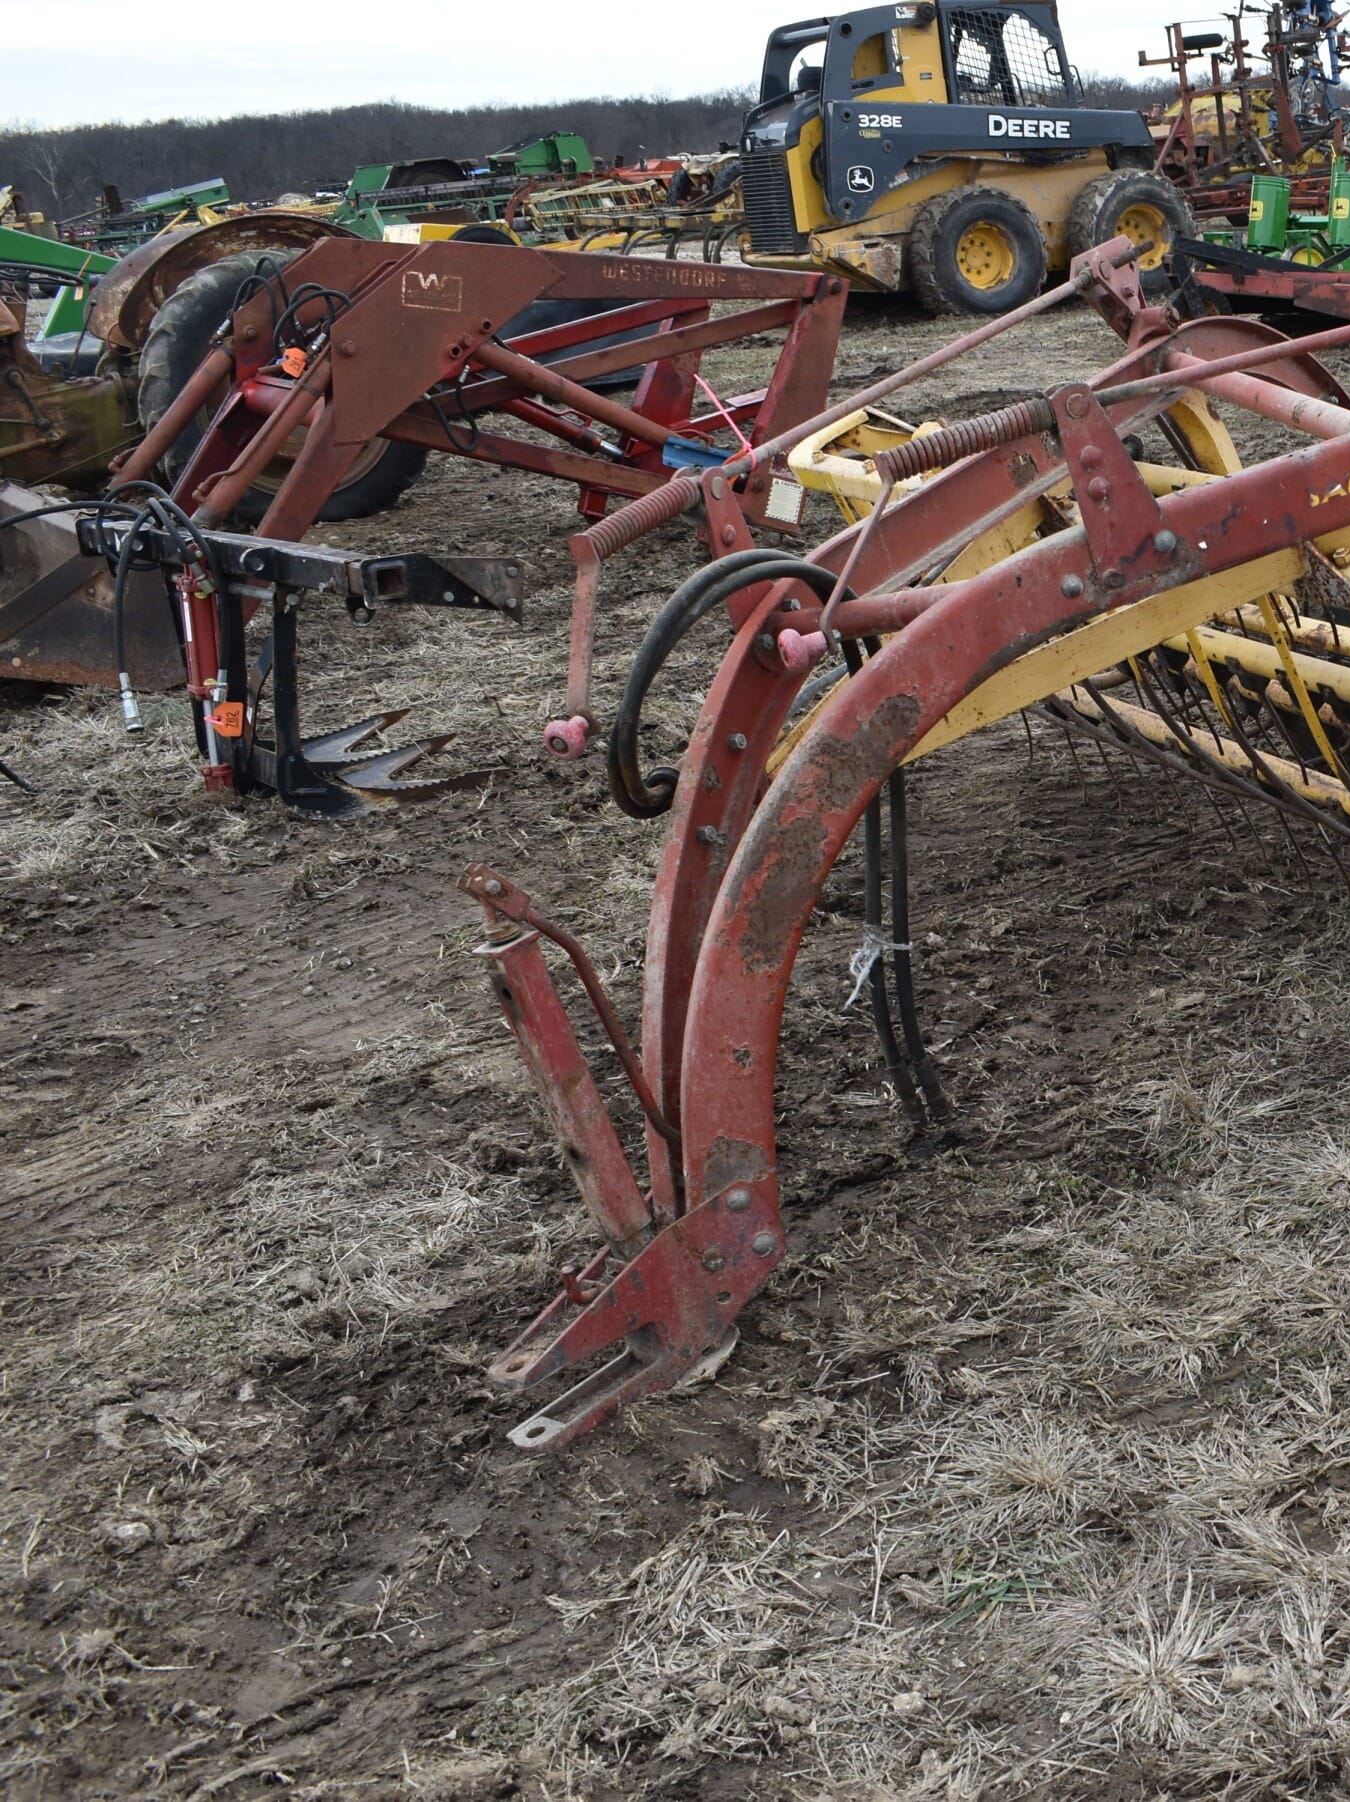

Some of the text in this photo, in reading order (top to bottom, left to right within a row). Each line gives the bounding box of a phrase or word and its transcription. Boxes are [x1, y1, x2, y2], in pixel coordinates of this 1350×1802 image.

[858, 114, 903, 128] 328E
[988, 114, 1071, 139] DEERE
[225, 711, 237, 729] 762
